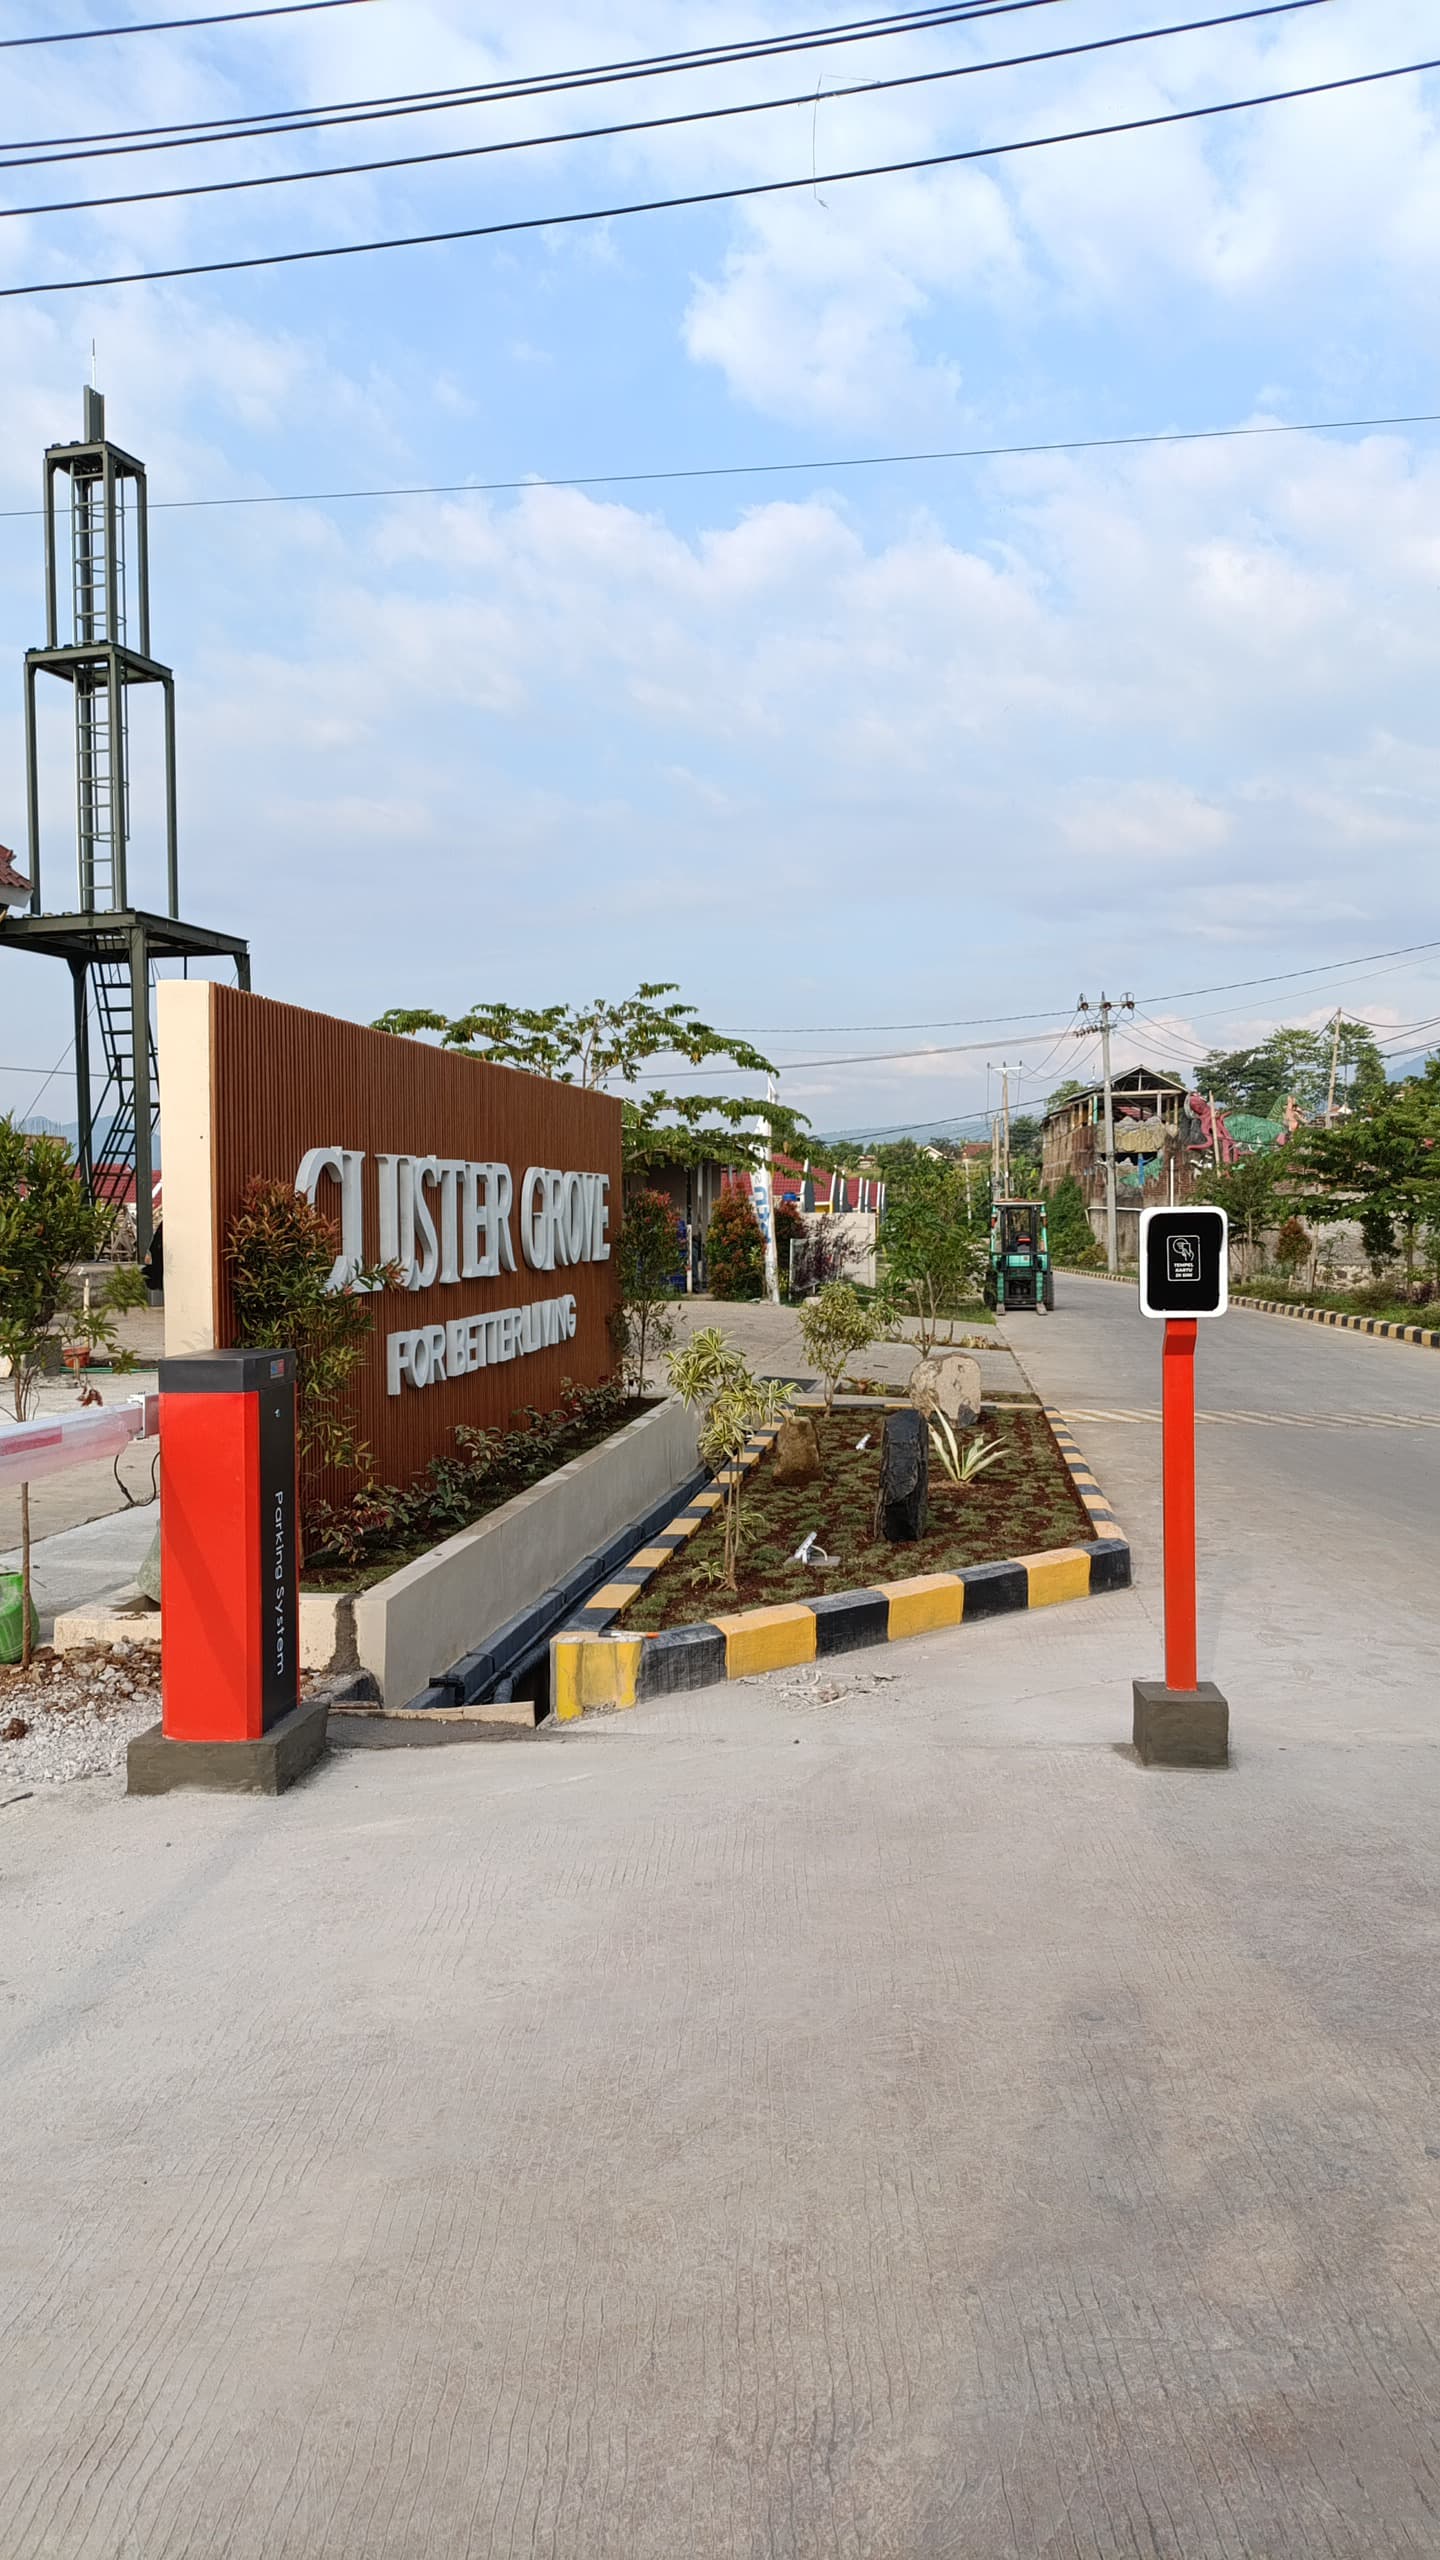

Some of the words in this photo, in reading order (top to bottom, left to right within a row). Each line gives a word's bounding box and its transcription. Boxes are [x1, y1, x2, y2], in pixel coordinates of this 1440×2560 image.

[521, 1166, 611, 1271] GROVE
[387, 1325, 447, 1395] FOR
[446, 1308, 524, 1377] BETTER
[522, 1294, 577, 1353] LIVING
[275, 1491, 285, 1580] Parking
[275, 1586, 285, 1675] System
